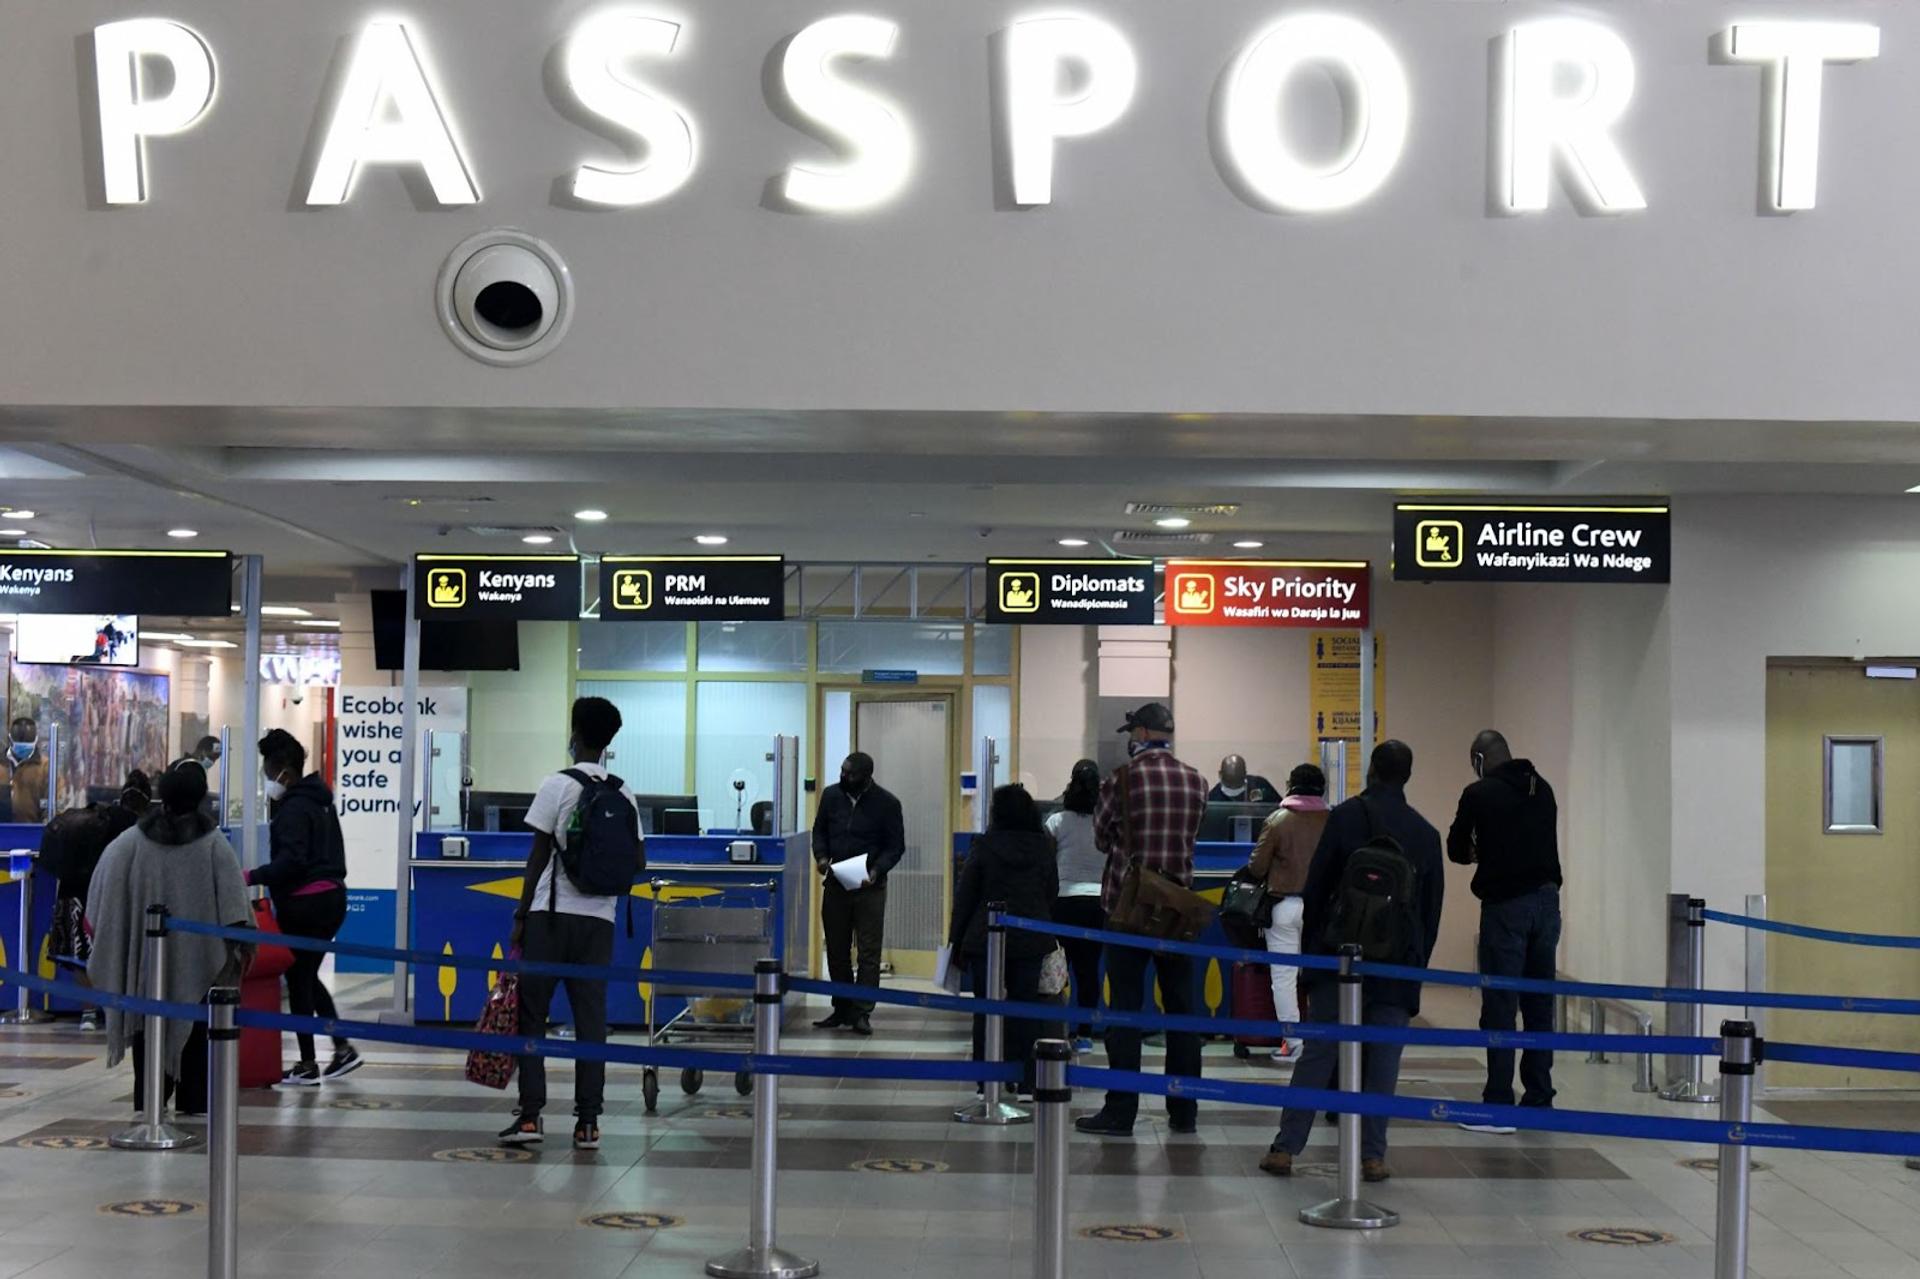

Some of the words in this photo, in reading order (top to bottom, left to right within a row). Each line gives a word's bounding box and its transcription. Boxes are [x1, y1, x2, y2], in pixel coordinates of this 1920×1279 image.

[94, 10, 1880, 211] PASSPORT
[1476, 521, 1565, 547] Airline
[1571, 523, 1642, 548] Crew
[1476, 552, 1570, 571] Wafanyikazi
[1573, 553, 1599, 567] Wa
[1602, 553, 1652, 572] Ndege
[0, 564, 75, 586] Kenyans
[479, 570, 556, 592] Kenyans
[664, 574, 706, 592] PRM
[0, 584, 41, 597] Wakenya
[1051, 574, 1145, 596] Diplomats
[1223, 575, 1266, 603] Sky
[1271, 576, 1357, 604] Priority
[478, 591, 522, 603] Wakenya
[664, 595, 714, 606] Wanaoishi
[715, 597, 727, 605] na
[728, 595, 770, 606] Ulemavu
[1050, 598, 1128, 611] Wanadiplomasia
[1223, 606, 1269, 618] Wasafiri
[1271, 608, 1289, 618] wa
[1291, 607, 1328, 621] Daraja
[342, 720, 403, 739] wishe
[342, 748, 381, 767] you
[388, 749, 402, 764] a
[341, 769, 389, 788] safe
[340, 793, 423, 817] journy
